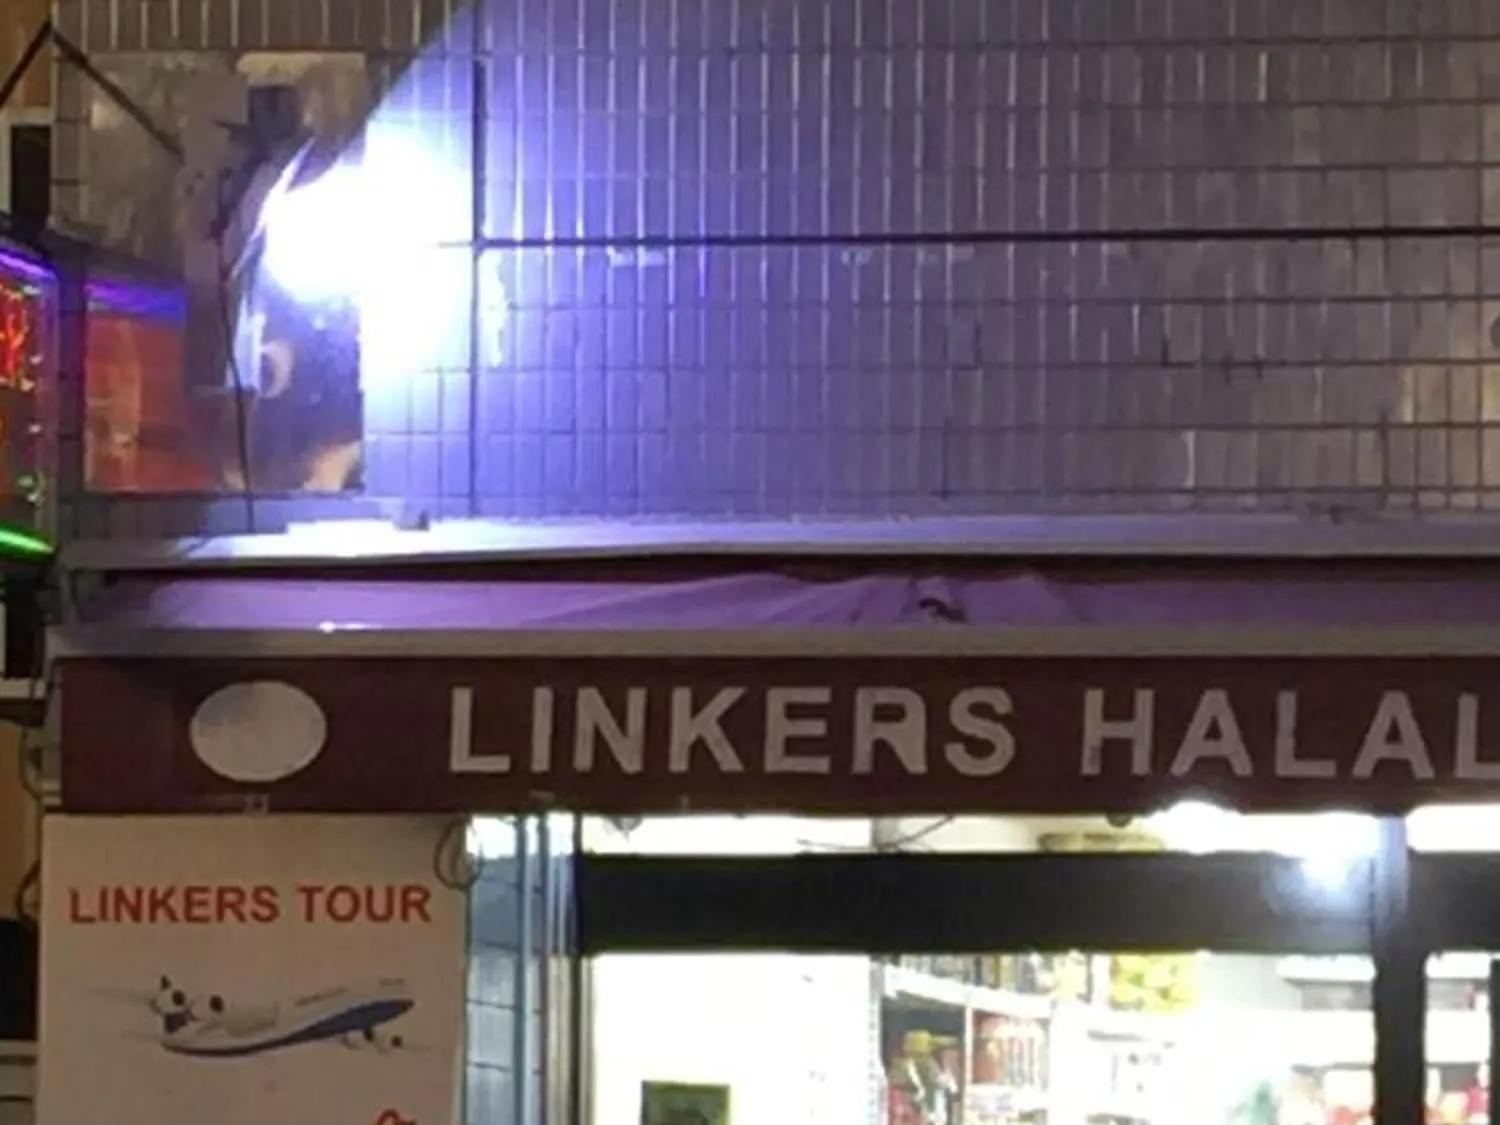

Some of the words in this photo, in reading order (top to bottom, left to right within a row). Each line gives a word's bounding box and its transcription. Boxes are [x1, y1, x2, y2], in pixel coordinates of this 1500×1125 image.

[448, 685, 1016, 777] LINKERS
[69, 885, 280, 924] LINKERS
[297, 884, 432, 923] TOUR
